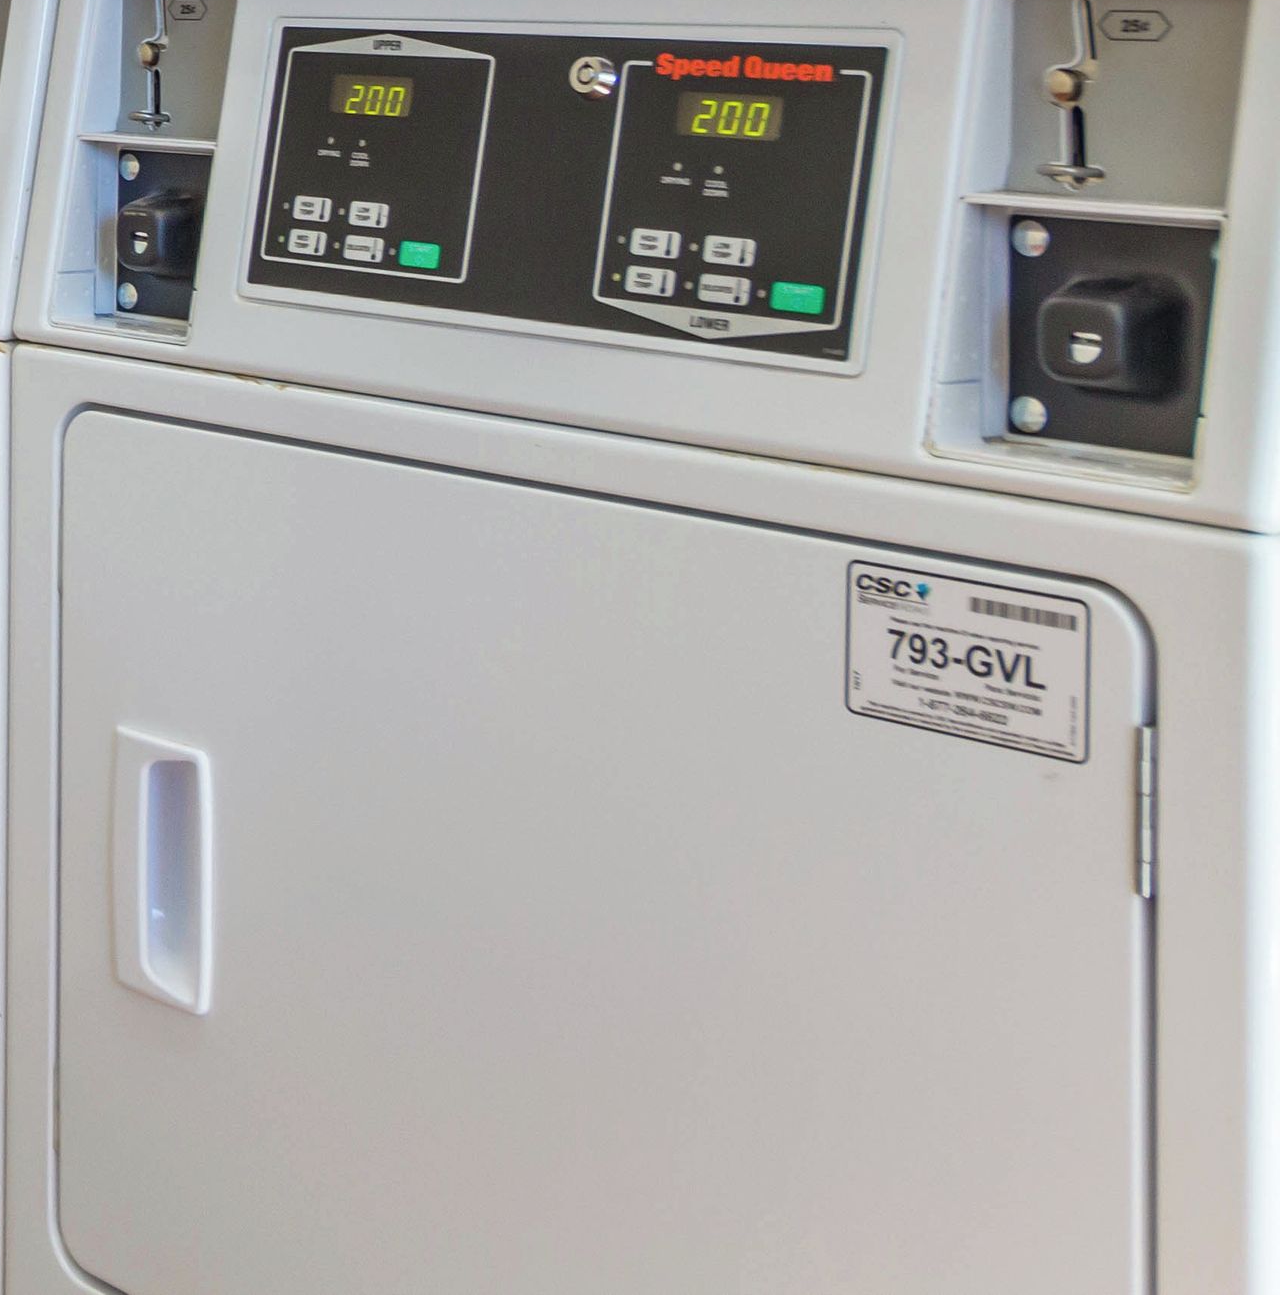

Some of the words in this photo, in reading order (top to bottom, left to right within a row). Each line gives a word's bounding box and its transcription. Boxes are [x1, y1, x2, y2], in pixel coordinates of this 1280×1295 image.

[373, 39, 402, 51] UPPER
[655, 53, 741, 81] Speed
[743, 55, 834, 82] Queen
[344, 85, 406, 117] 200
[691, 100, 771, 137] 200
[690, 315, 731, 332] LOWER
[856, 573, 911, 597] CSC
[887, 628, 1047, 691] 793-GVL
